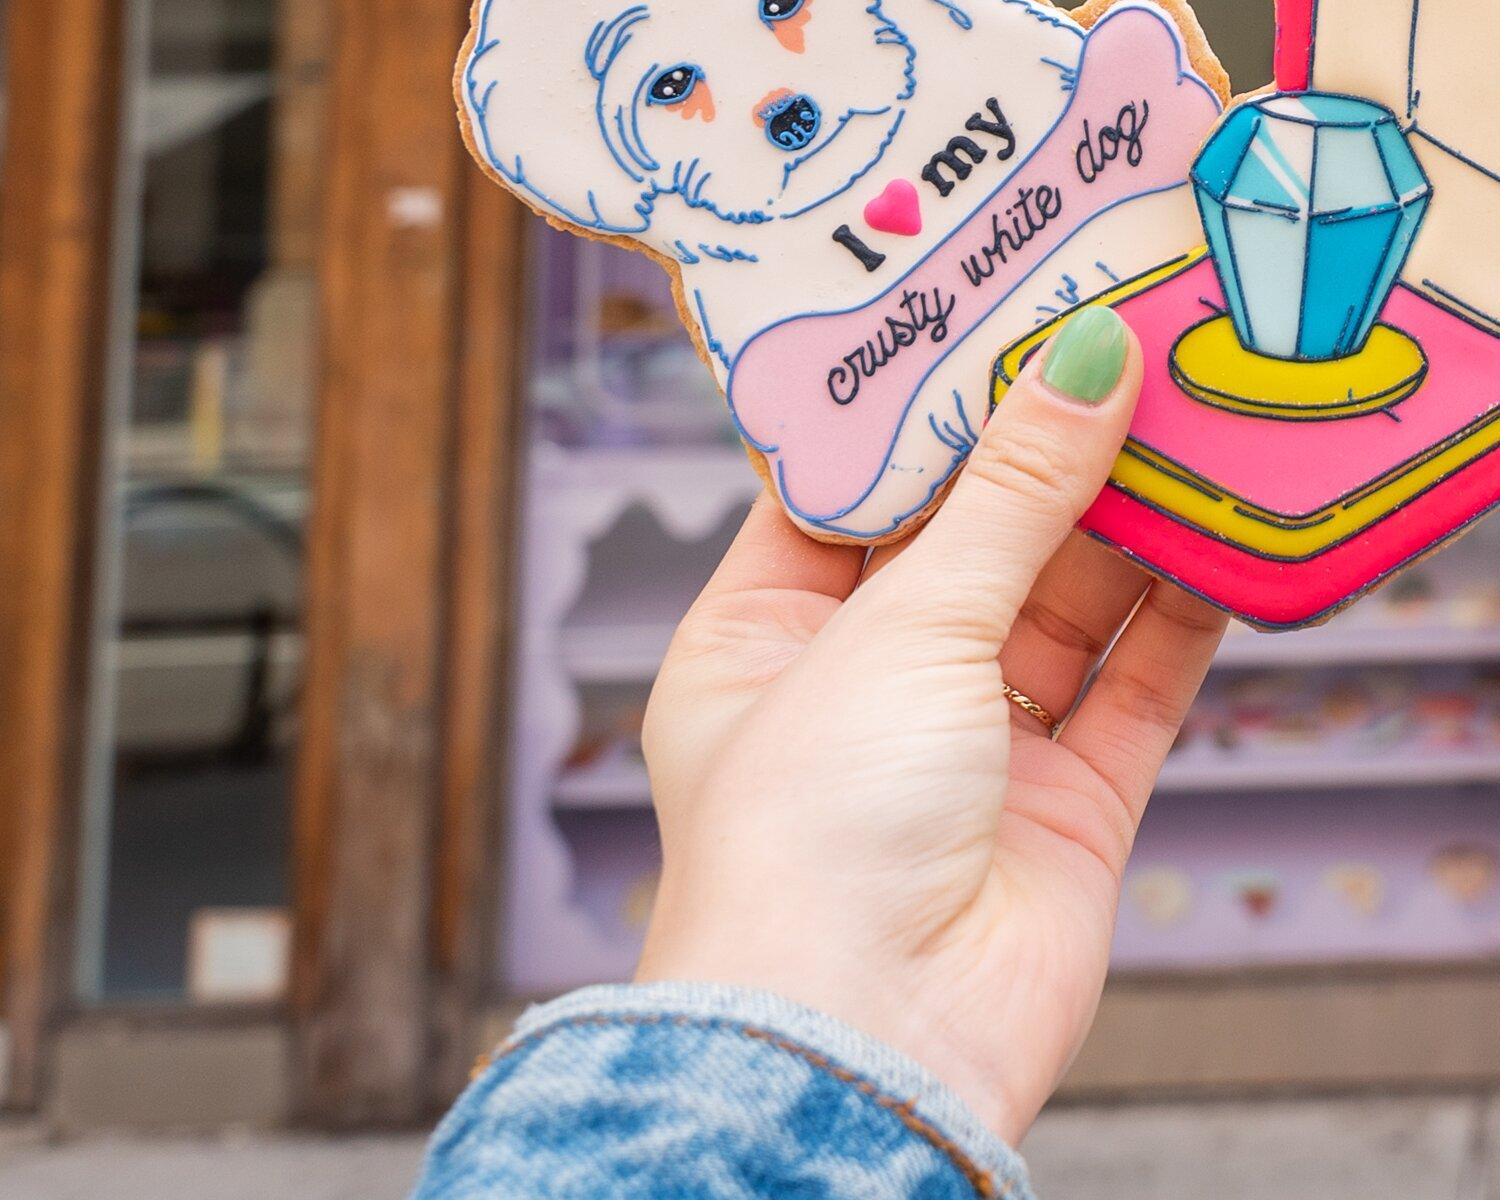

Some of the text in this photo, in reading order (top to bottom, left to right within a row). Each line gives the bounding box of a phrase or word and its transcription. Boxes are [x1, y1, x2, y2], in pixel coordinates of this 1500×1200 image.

[921, 97, 1017, 197] my
[827, 99, 1150, 406] crusty white dog
